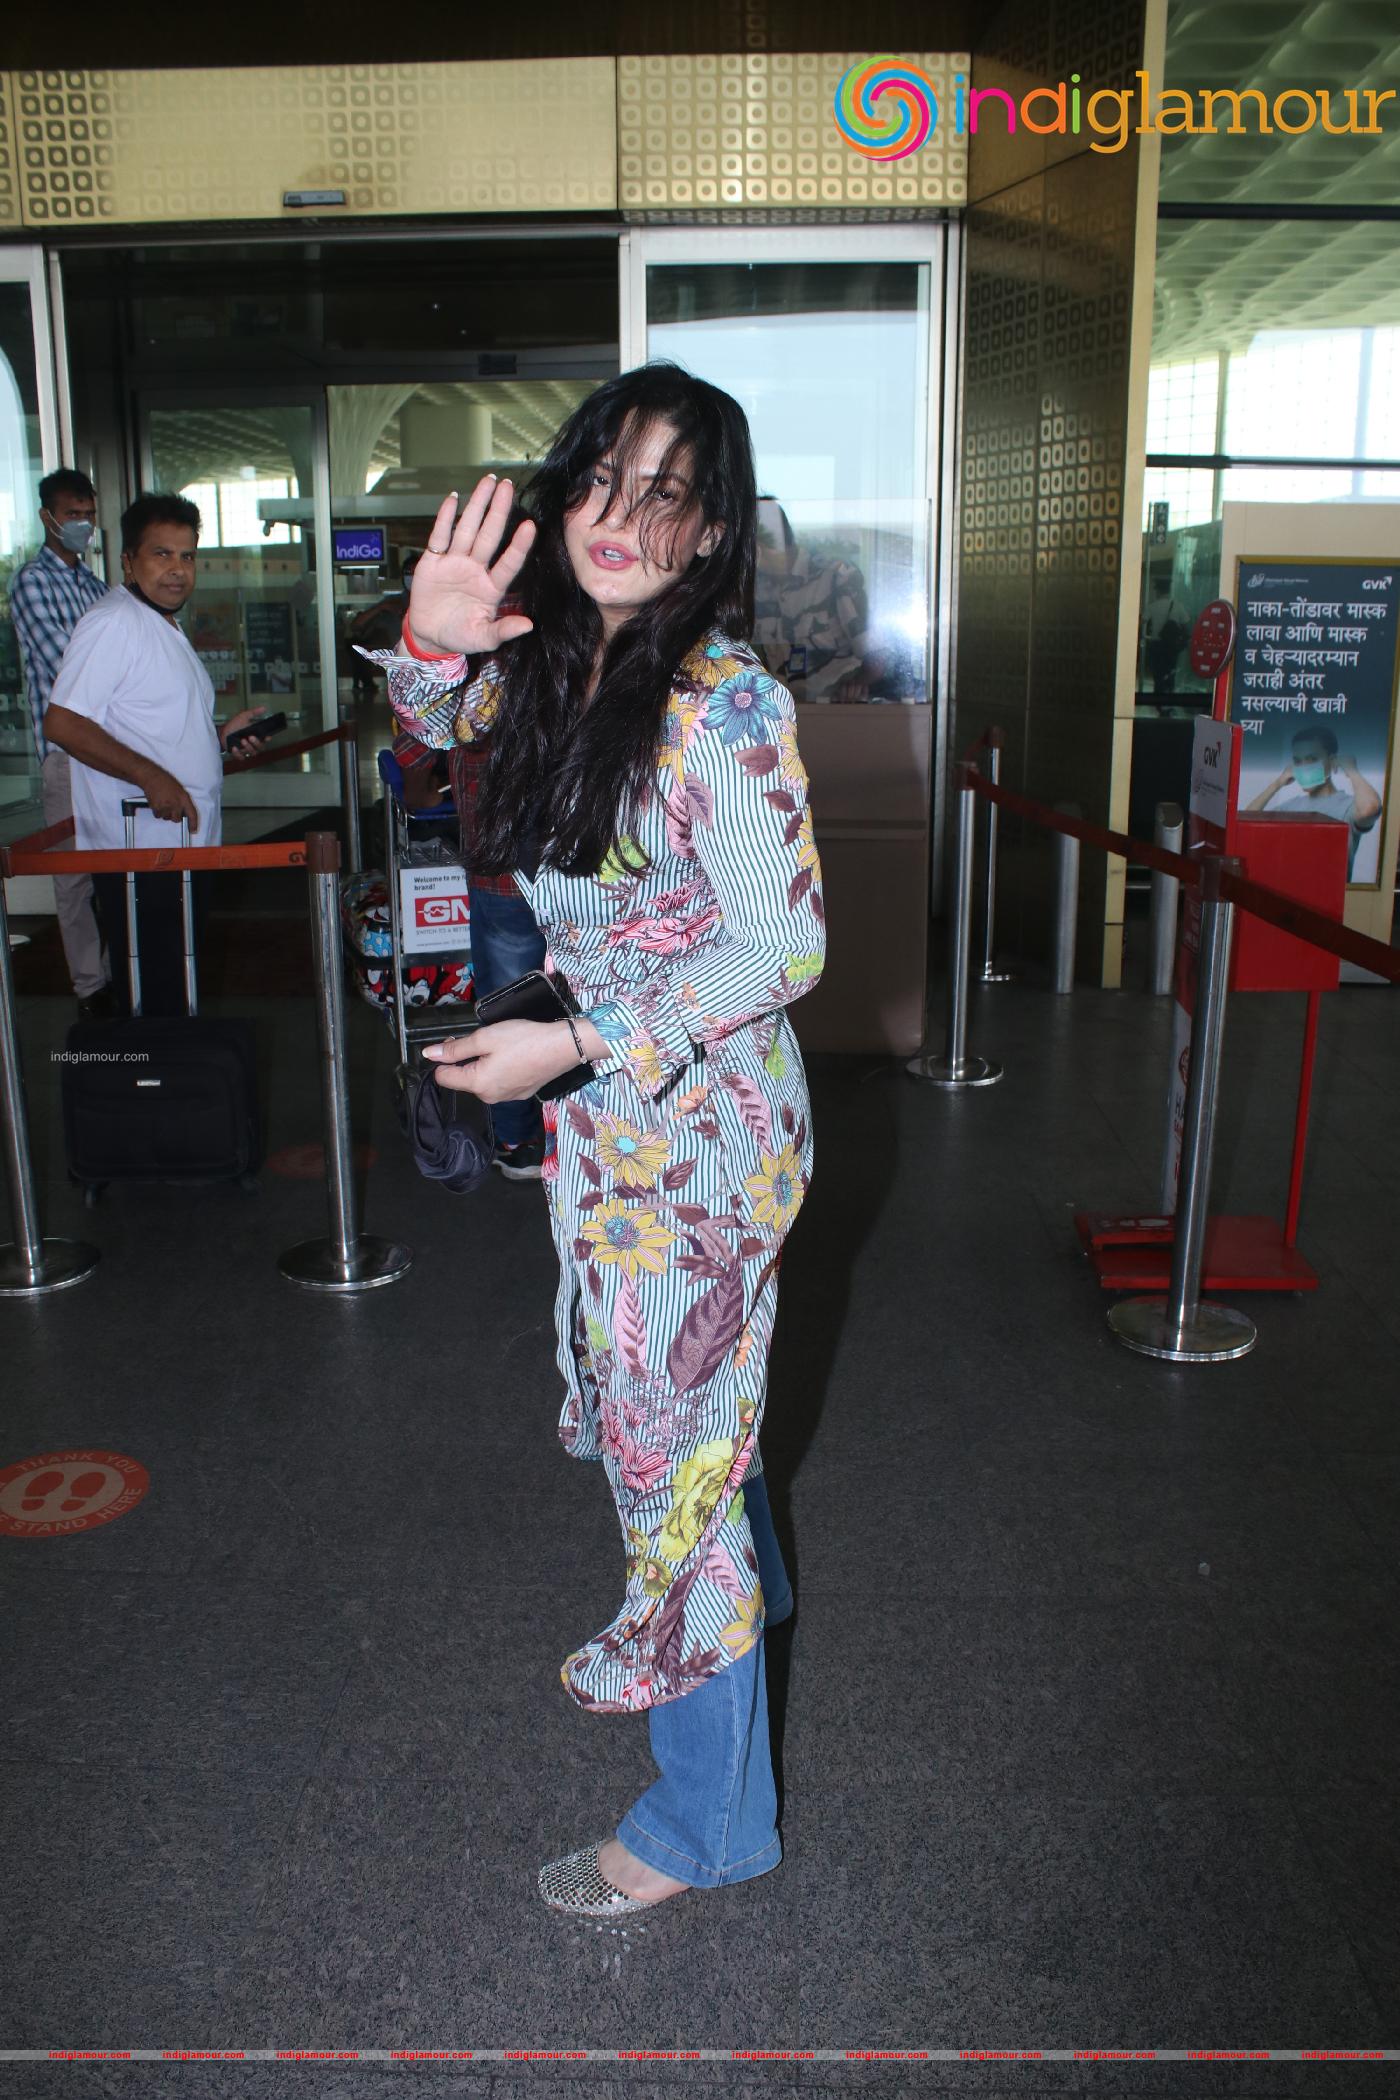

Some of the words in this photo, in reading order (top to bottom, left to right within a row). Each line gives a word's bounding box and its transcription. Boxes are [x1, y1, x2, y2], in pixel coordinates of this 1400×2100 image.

[336, 544, 381, 558] IndiGo
[1362, 577, 1389, 590] GVK
[1247, 596, 1343, 618] नाका-तोंडावर
[1347, 602, 1388, 619] मास्क
[1246, 625, 1281, 641] लावा
[1285, 621, 1323, 642] आणि
[1327, 626, 1368, 643] मास्क
[1245, 649, 1257, 665] व
[1243, 668, 1285, 690] जराही
[1288, 669, 1325, 689] अंतर
[1241, 693, 1308, 713] नसल्याची
[1312, 694, 1347, 713] खात्री
[1204, 746, 1218, 768] GVK
[414, 875, 442, 883] Welcome
[16, 1452, 96, 1472] THANK
[106, 1455, 140, 1473] YOU
[10, 1518, 88, 1533] STAND
[96, 1487, 142, 1519] HERE
